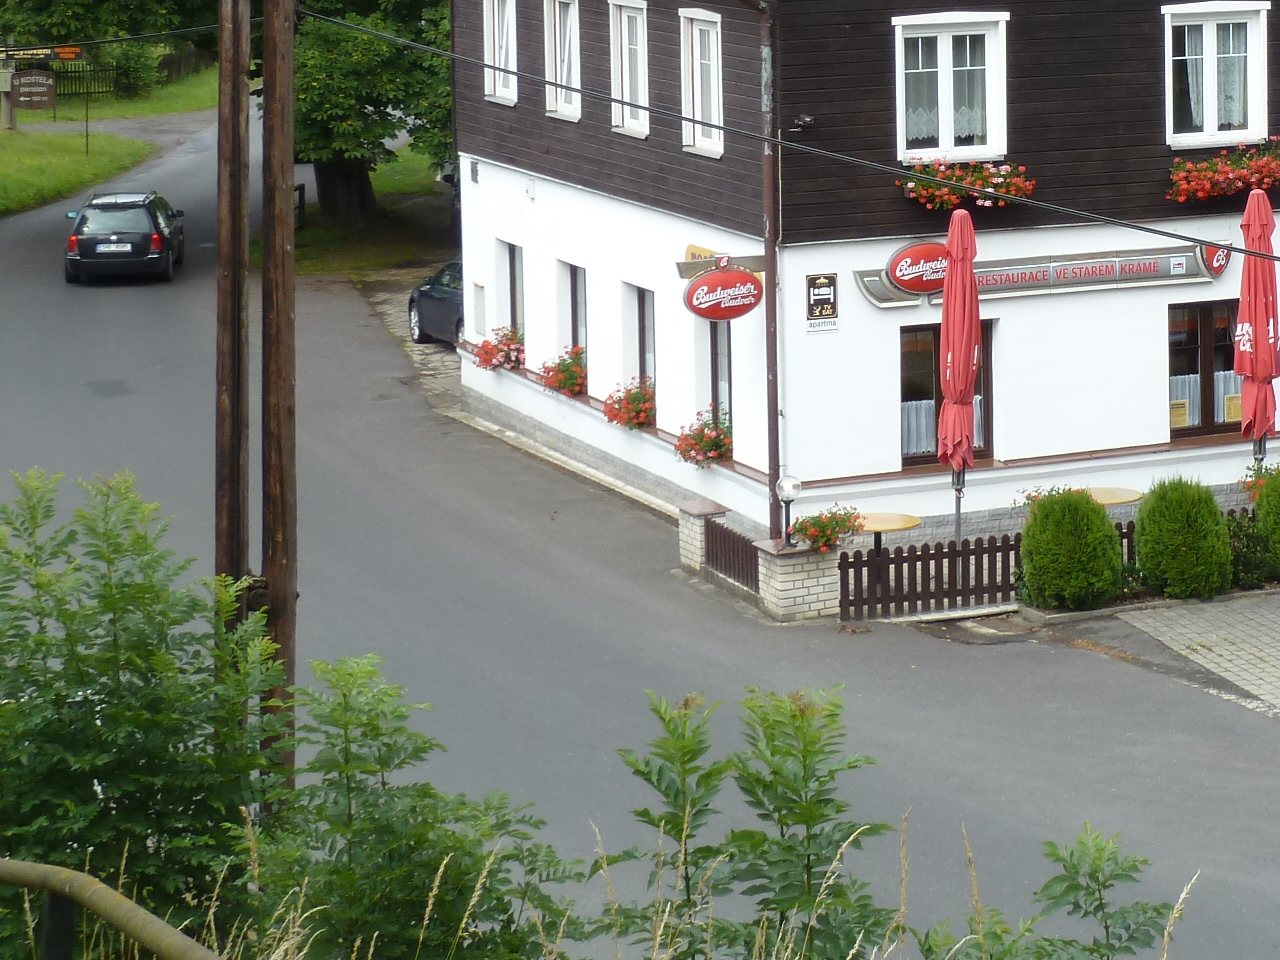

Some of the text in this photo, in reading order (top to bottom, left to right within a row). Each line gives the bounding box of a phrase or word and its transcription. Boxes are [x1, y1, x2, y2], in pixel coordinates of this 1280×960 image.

[21, 76, 53, 86] KOSTELA
[978, 270, 1049, 287] RESTAURACE
[1055, 268, 1069, 280] VE
[1072, 262, 1115, 279] STARÉM
[692, 283, 758, 307] Budweiser
[721, 296, 756, 308] Budvar
